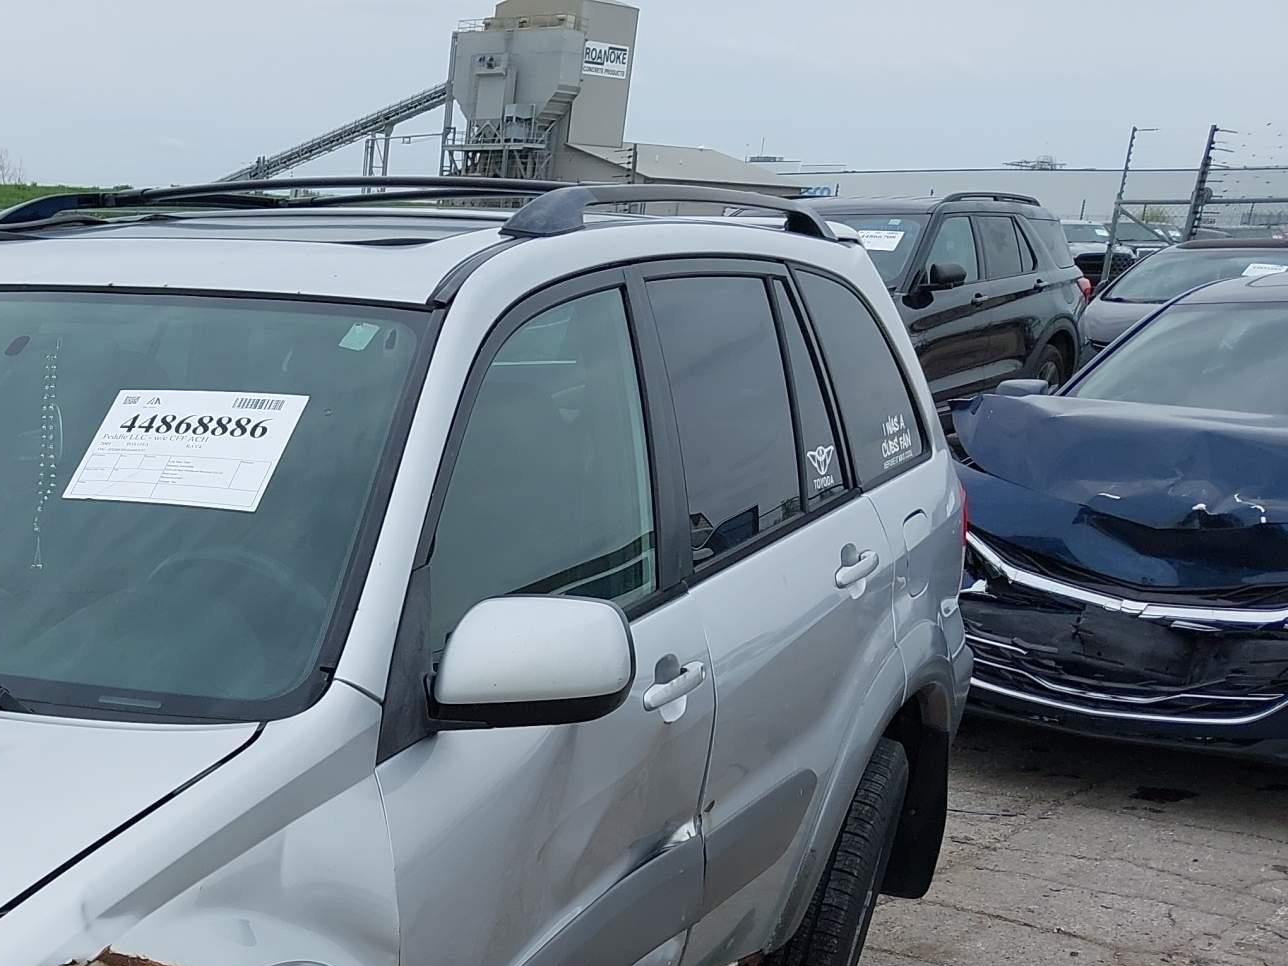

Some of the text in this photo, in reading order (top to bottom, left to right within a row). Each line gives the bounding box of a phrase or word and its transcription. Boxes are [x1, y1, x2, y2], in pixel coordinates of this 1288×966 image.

[584, 47, 627, 65] ROANOKE
[120, 414, 273, 439] 44868886
[886, 416, 899, 436] WAS
[899, 413, 906, 430] A
[882, 429, 912, 457] CUBS FAN
